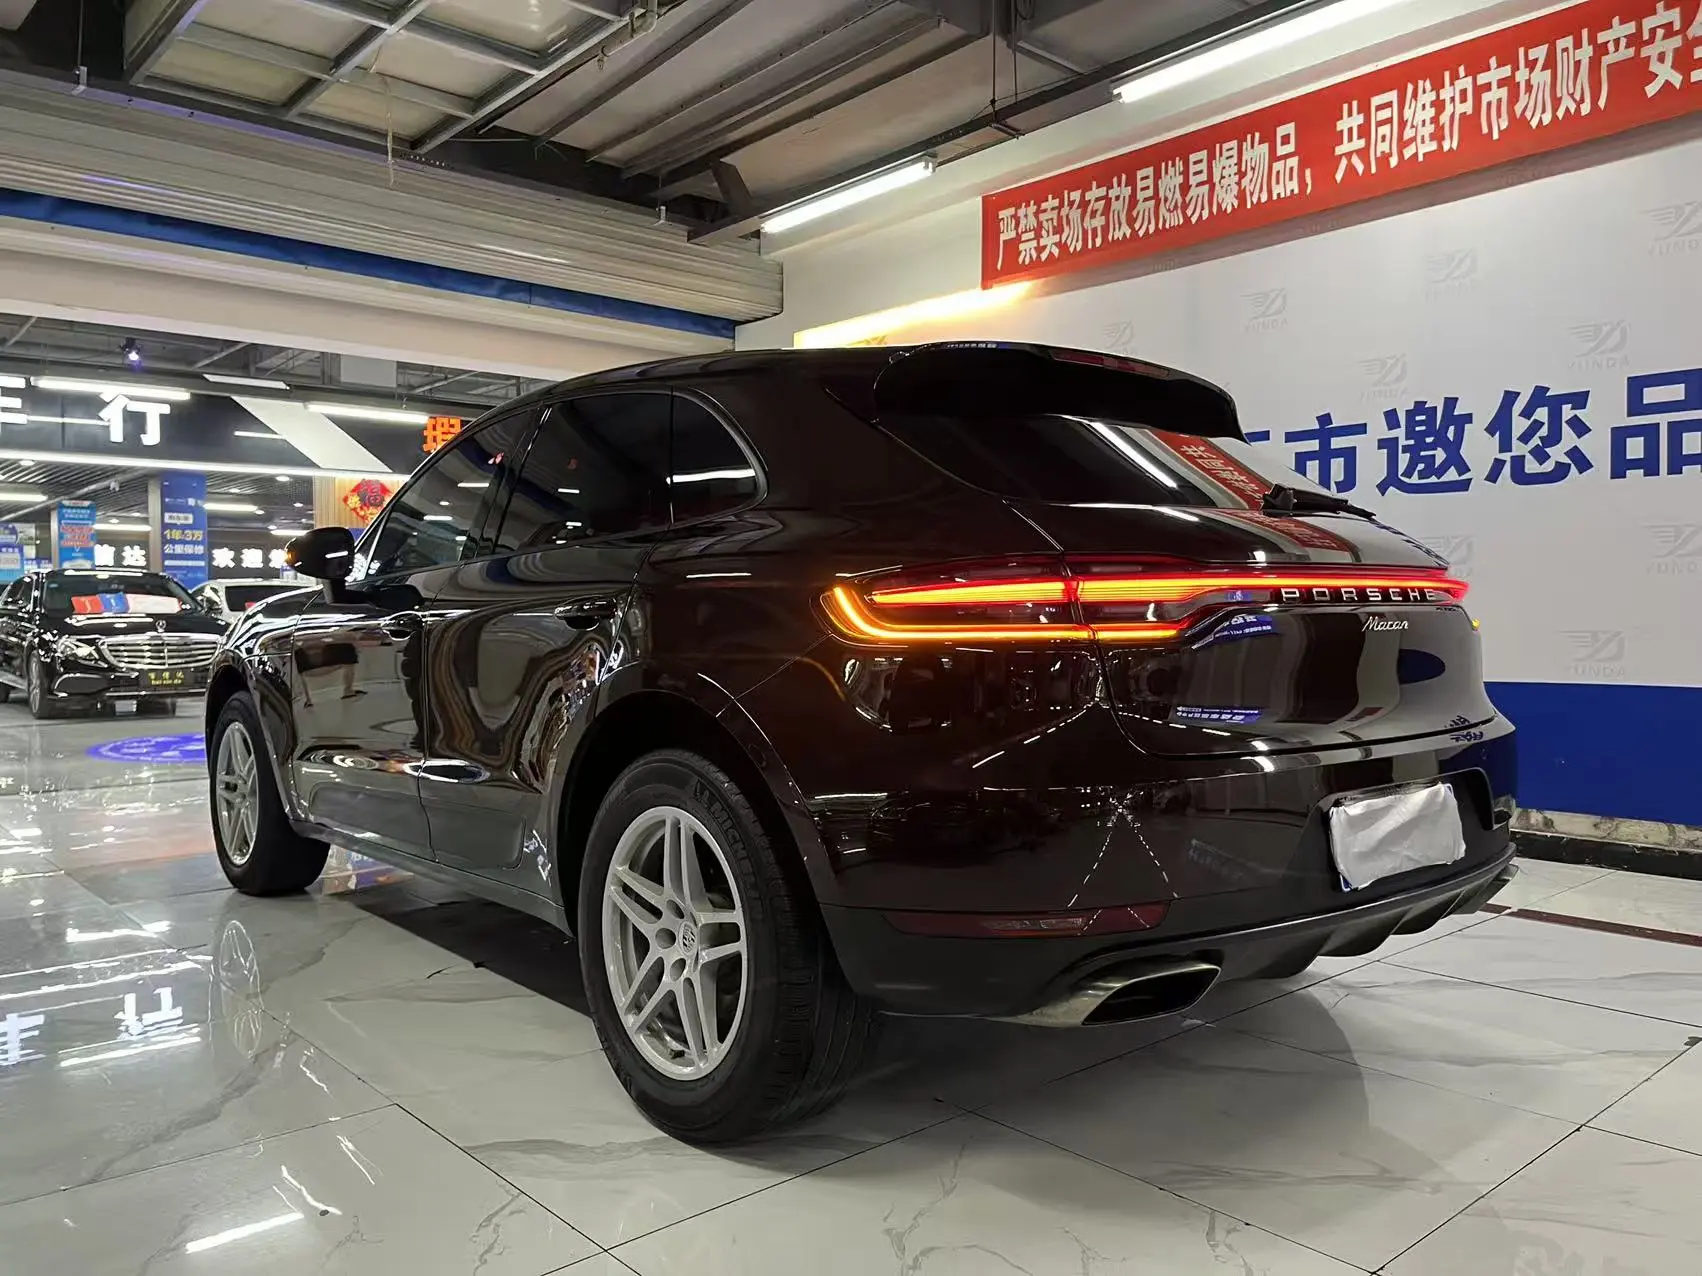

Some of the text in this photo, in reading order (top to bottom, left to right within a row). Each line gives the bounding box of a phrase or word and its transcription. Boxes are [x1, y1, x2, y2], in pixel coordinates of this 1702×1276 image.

[1244, 368, 1702, 496] 市邀您品
[1281, 587, 1437, 602] PORSCHE
[1362, 615, 1409, 632] Macan
